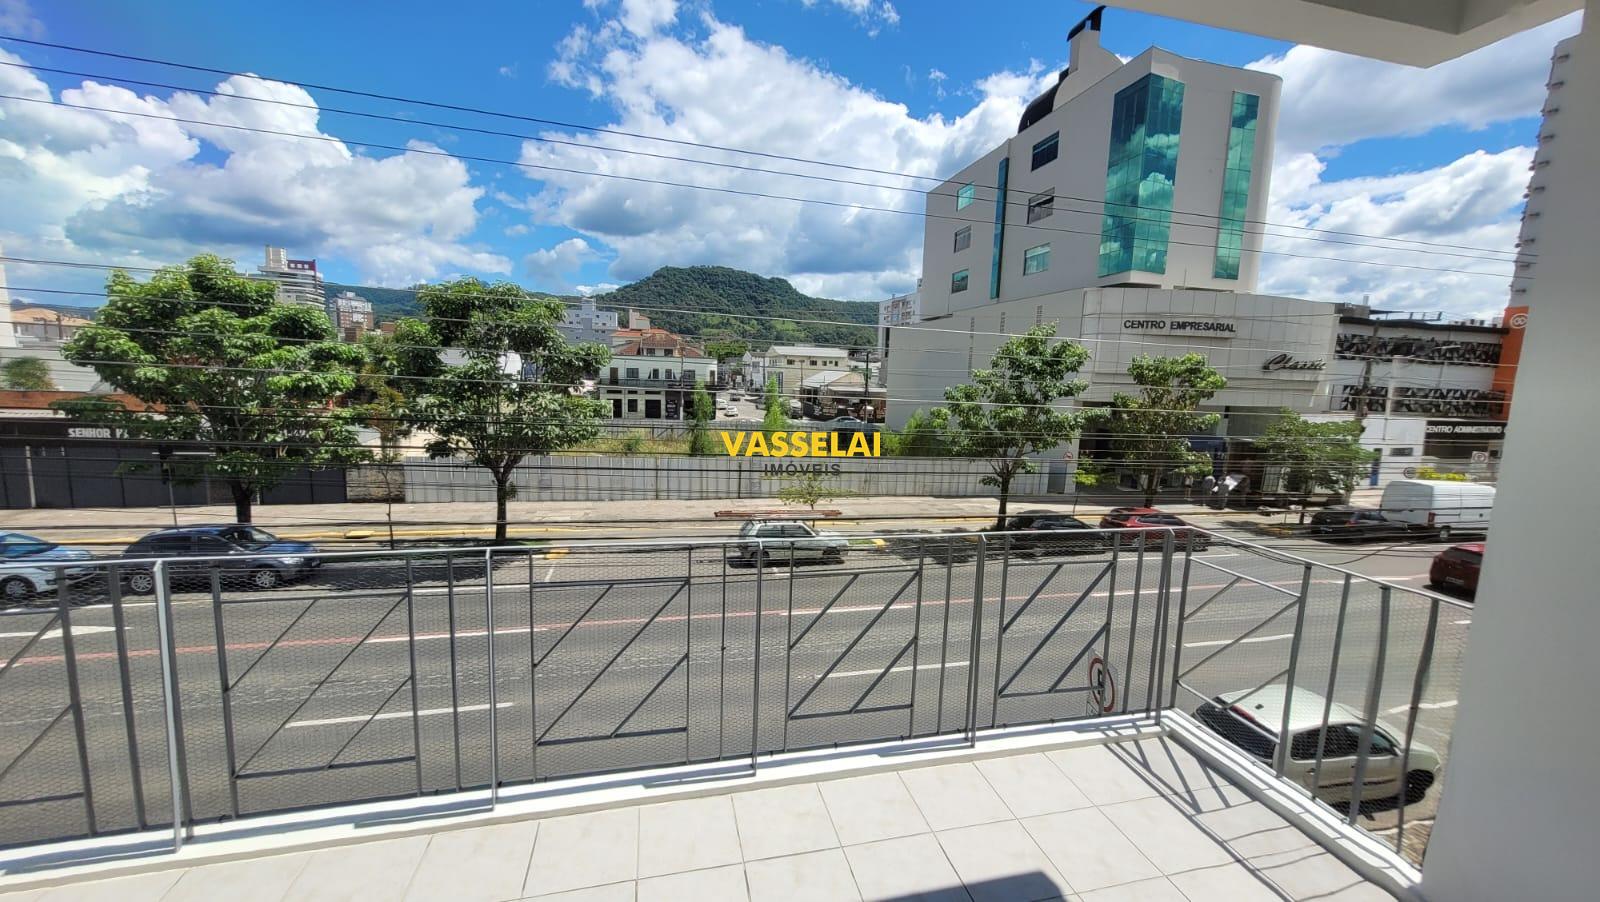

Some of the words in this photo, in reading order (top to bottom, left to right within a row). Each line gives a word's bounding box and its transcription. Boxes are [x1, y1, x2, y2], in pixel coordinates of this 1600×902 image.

[1123, 320, 1166, 329] CENTRO
[1170, 321, 1236, 333] EMPRESARIAL
[67, 427, 112, 439] SENHOR
[1425, 425, 1453, 433] CENTRO
